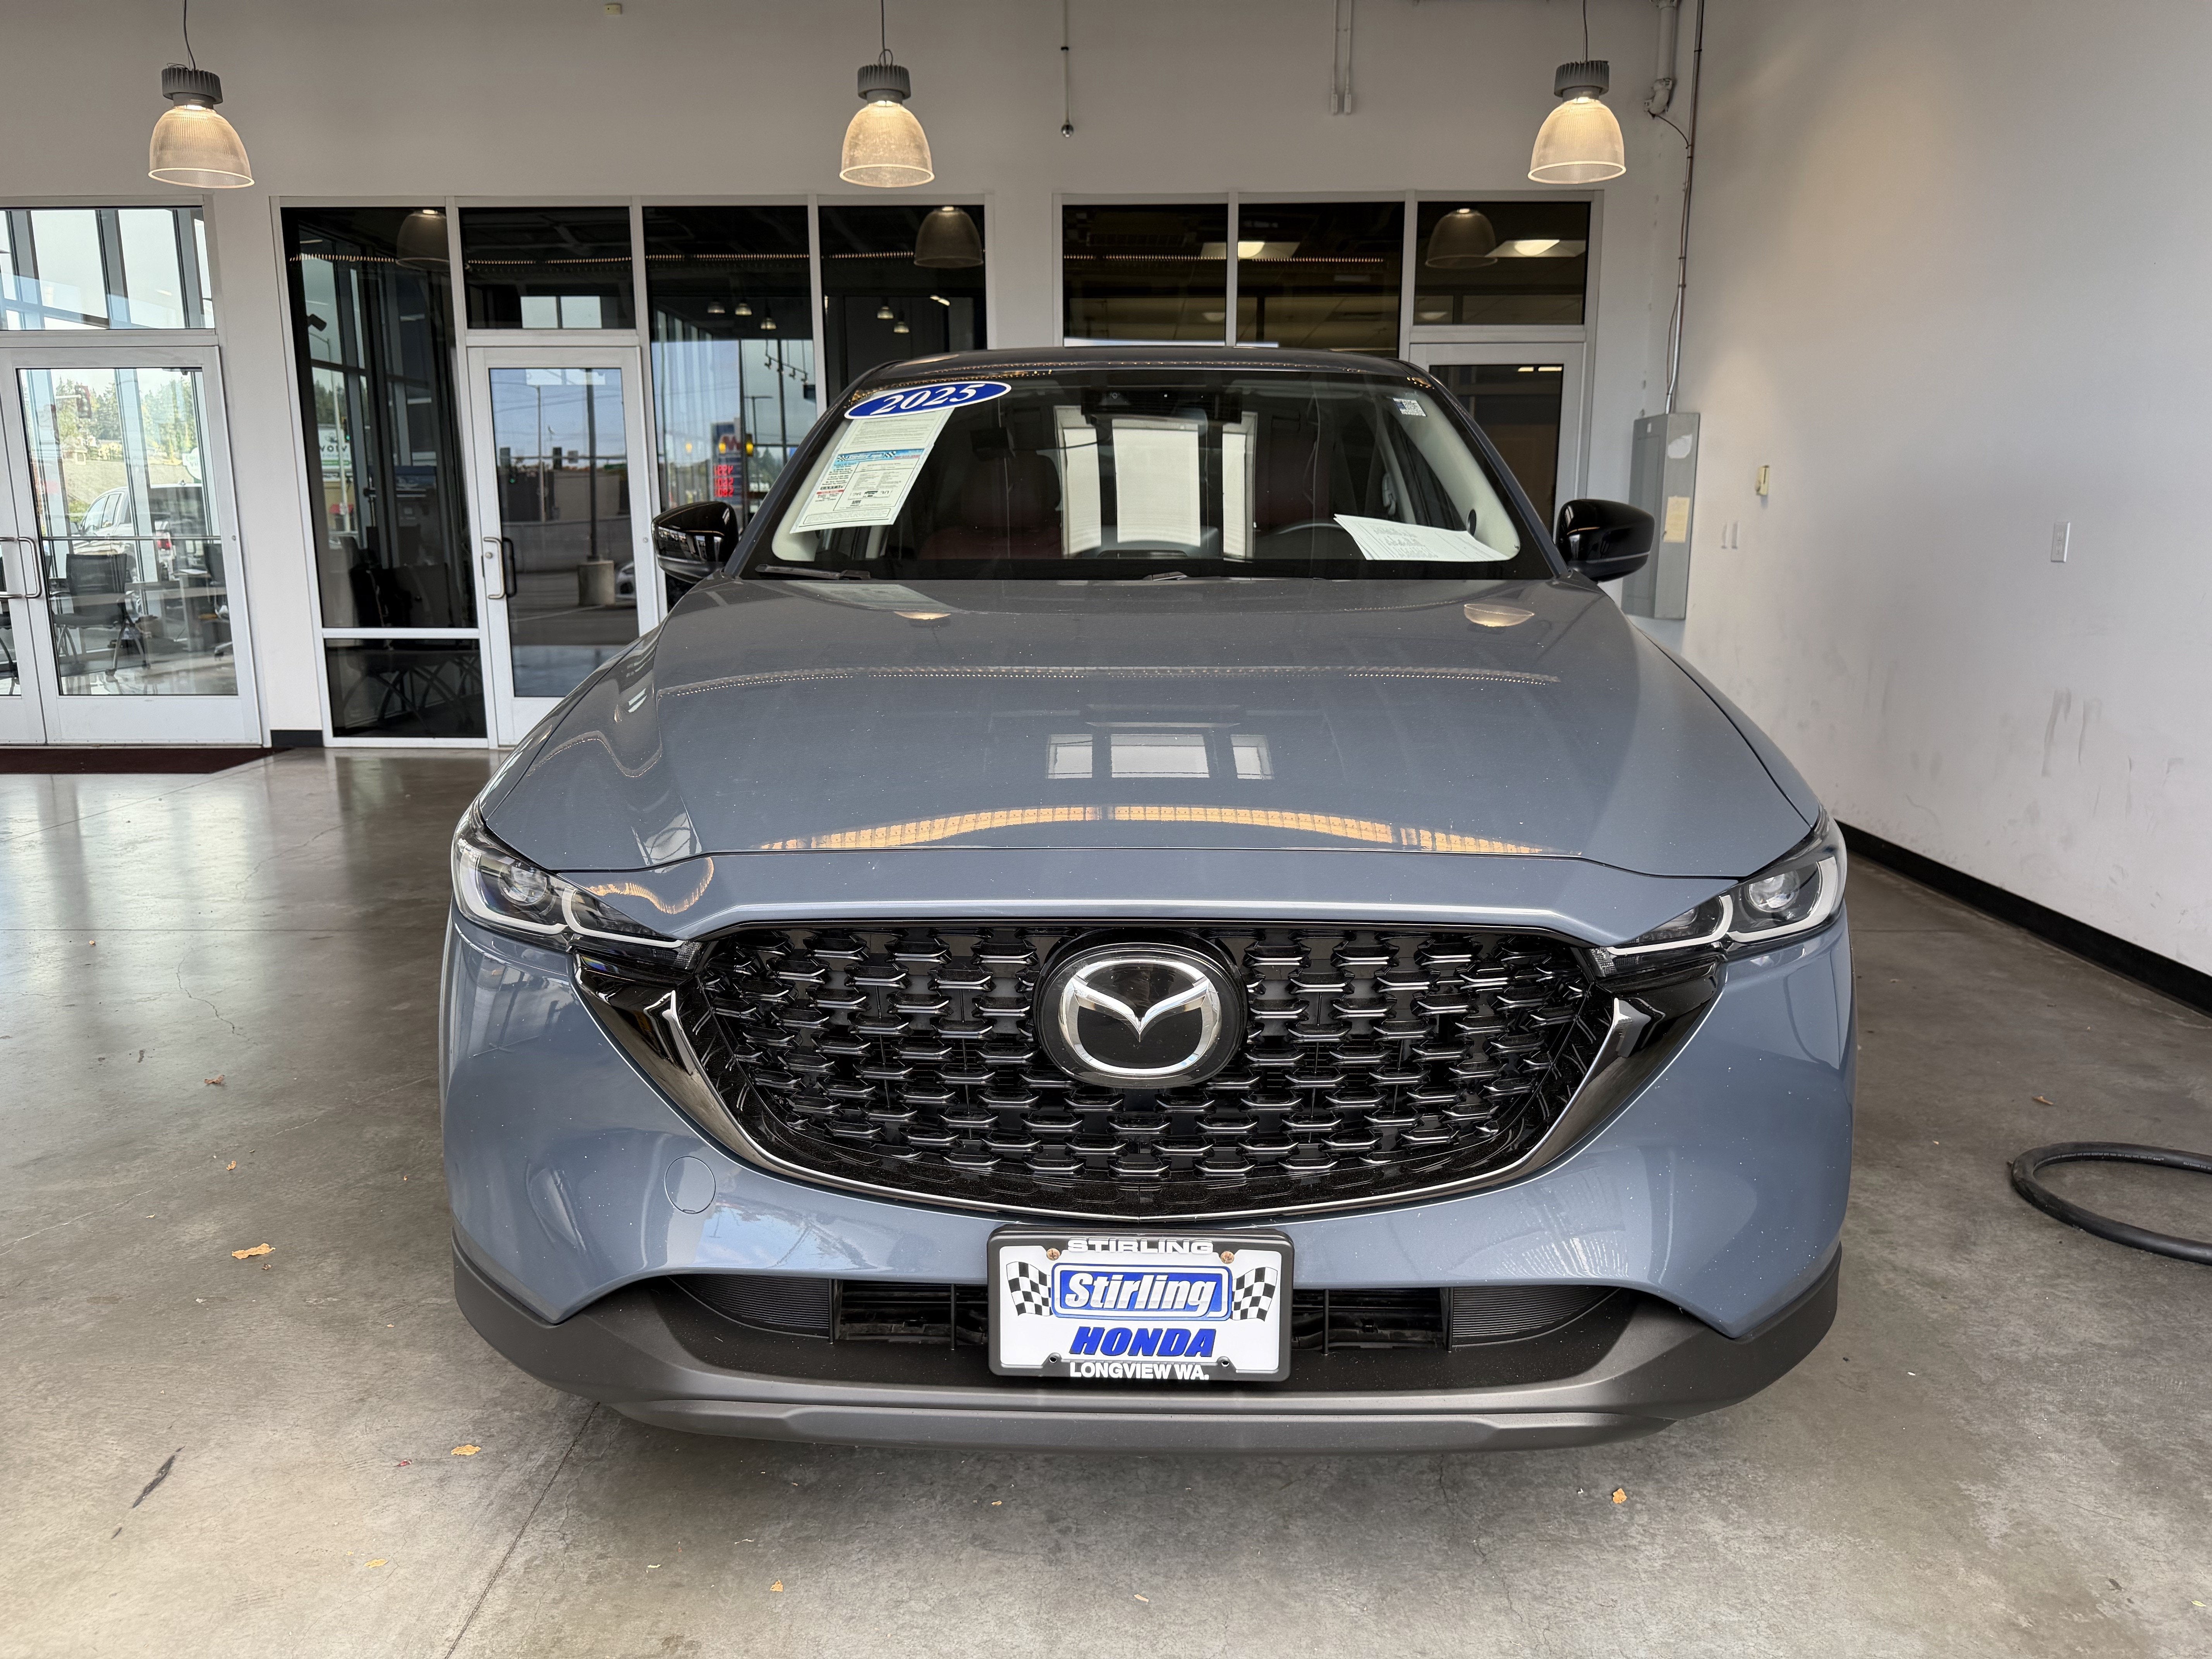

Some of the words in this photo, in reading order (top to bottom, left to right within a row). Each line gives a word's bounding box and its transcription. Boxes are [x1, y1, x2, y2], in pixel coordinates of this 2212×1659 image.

[869, 383, 986, 416] 2025
[1068, 1238, 1214, 1254] STIRLING
[1065, 1273, 1217, 1317] Stirling
[1069, 1326, 1217, 1357] HONDA
[1070, 1362, 1172, 1380] LONGVIEW
[1173, 1363, 1210, 1380] WA.
